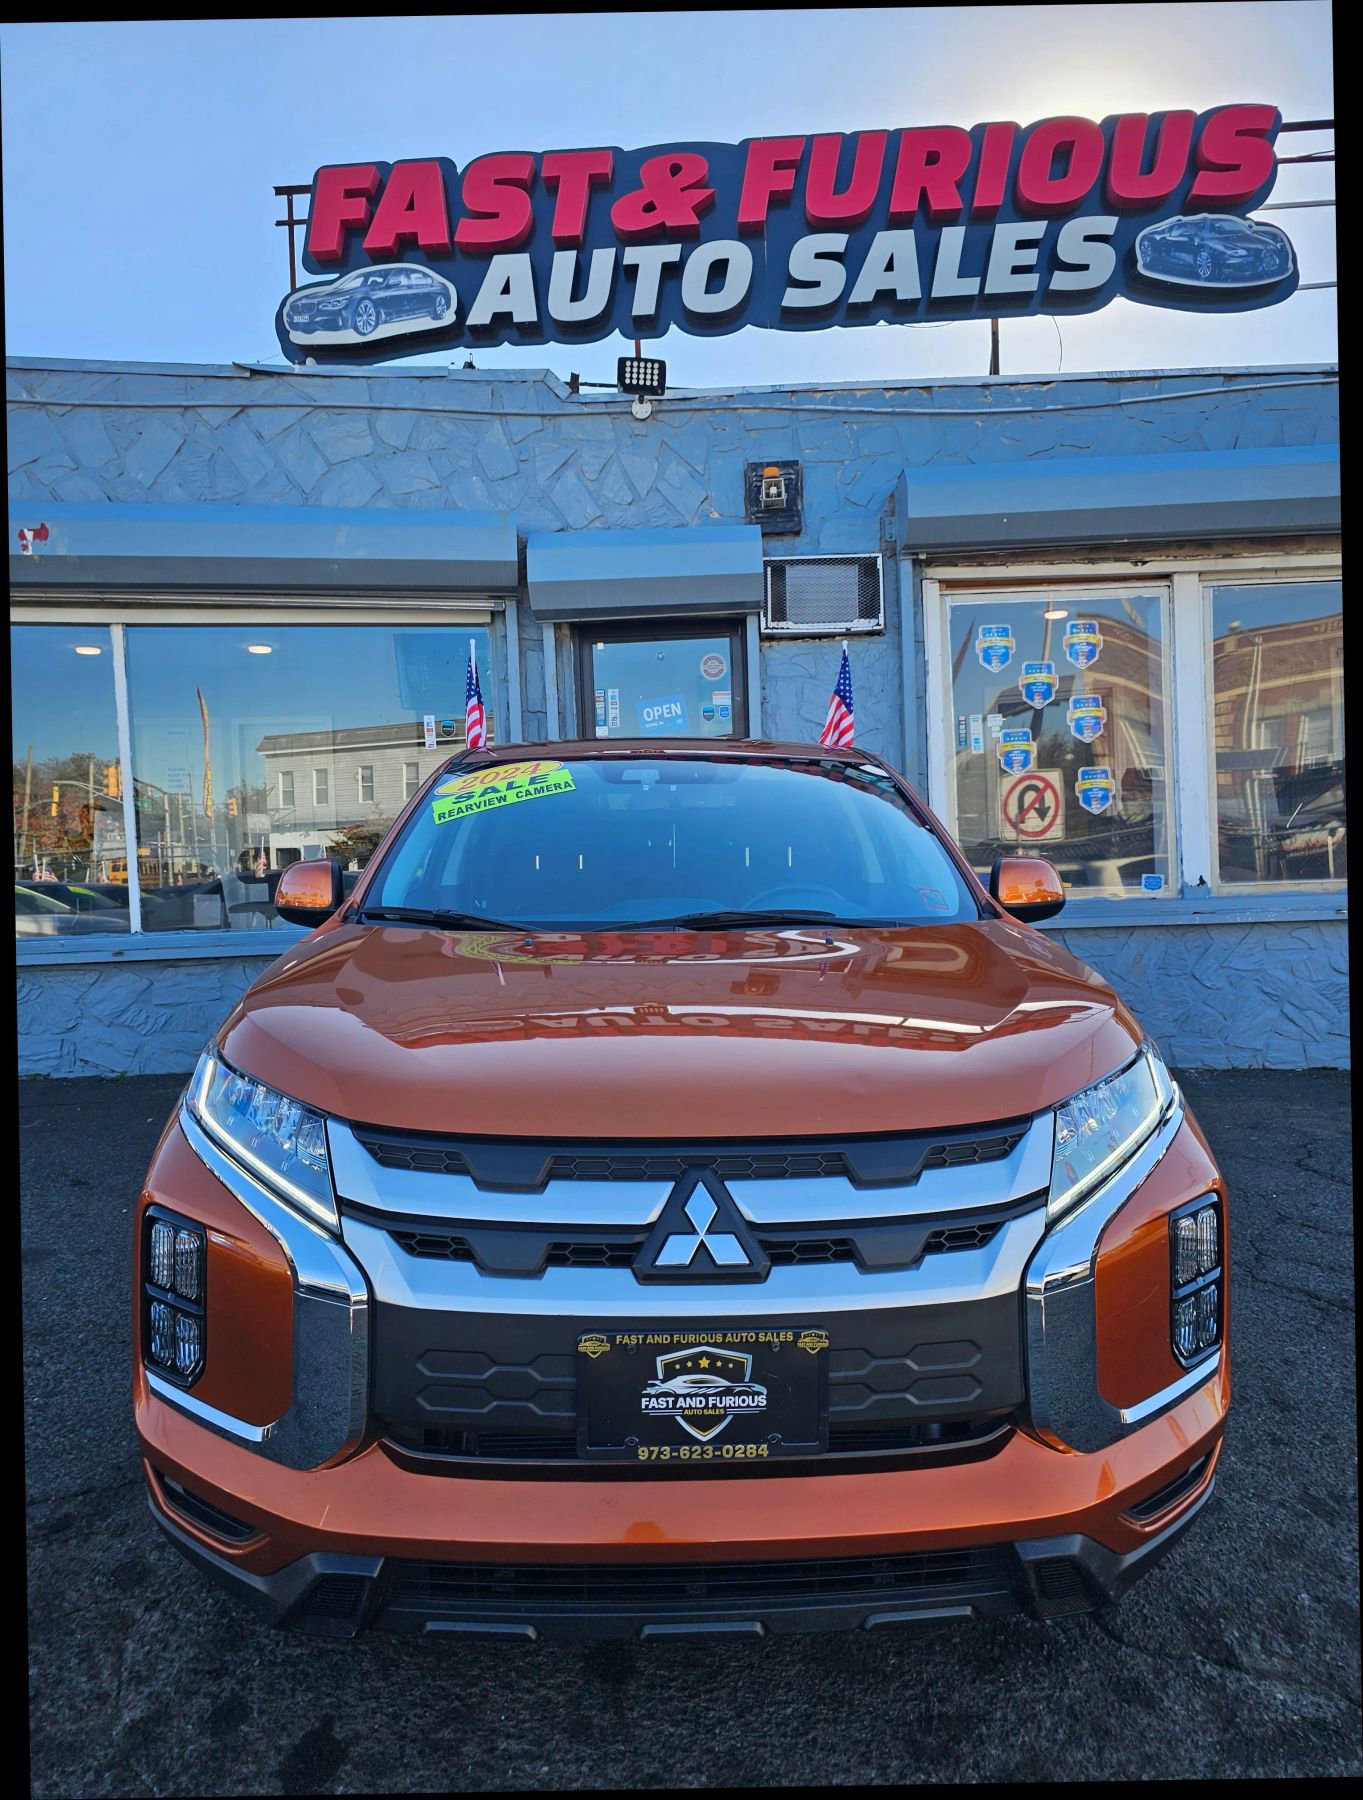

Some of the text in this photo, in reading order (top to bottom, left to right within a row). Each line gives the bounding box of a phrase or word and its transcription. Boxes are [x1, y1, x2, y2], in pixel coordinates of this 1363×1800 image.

[308, 104, 1279, 260] FAST & FURIOUS
[466, 215, 1120, 328] AUTO SALES
[643, 702, 681, 721] OPEN
[452, 774, 550, 804] SALE
[457, 762, 541, 791] 2024
[437, 782, 572, 821] REARVIEW CAMERA
[616, 1332, 793, 1345] FAST AND FURIOUS AUTO SALES
[641, 1394, 767, 1409] FAST AND FURIOUS
[637, 1444, 769, 1461] 973-623-0284
